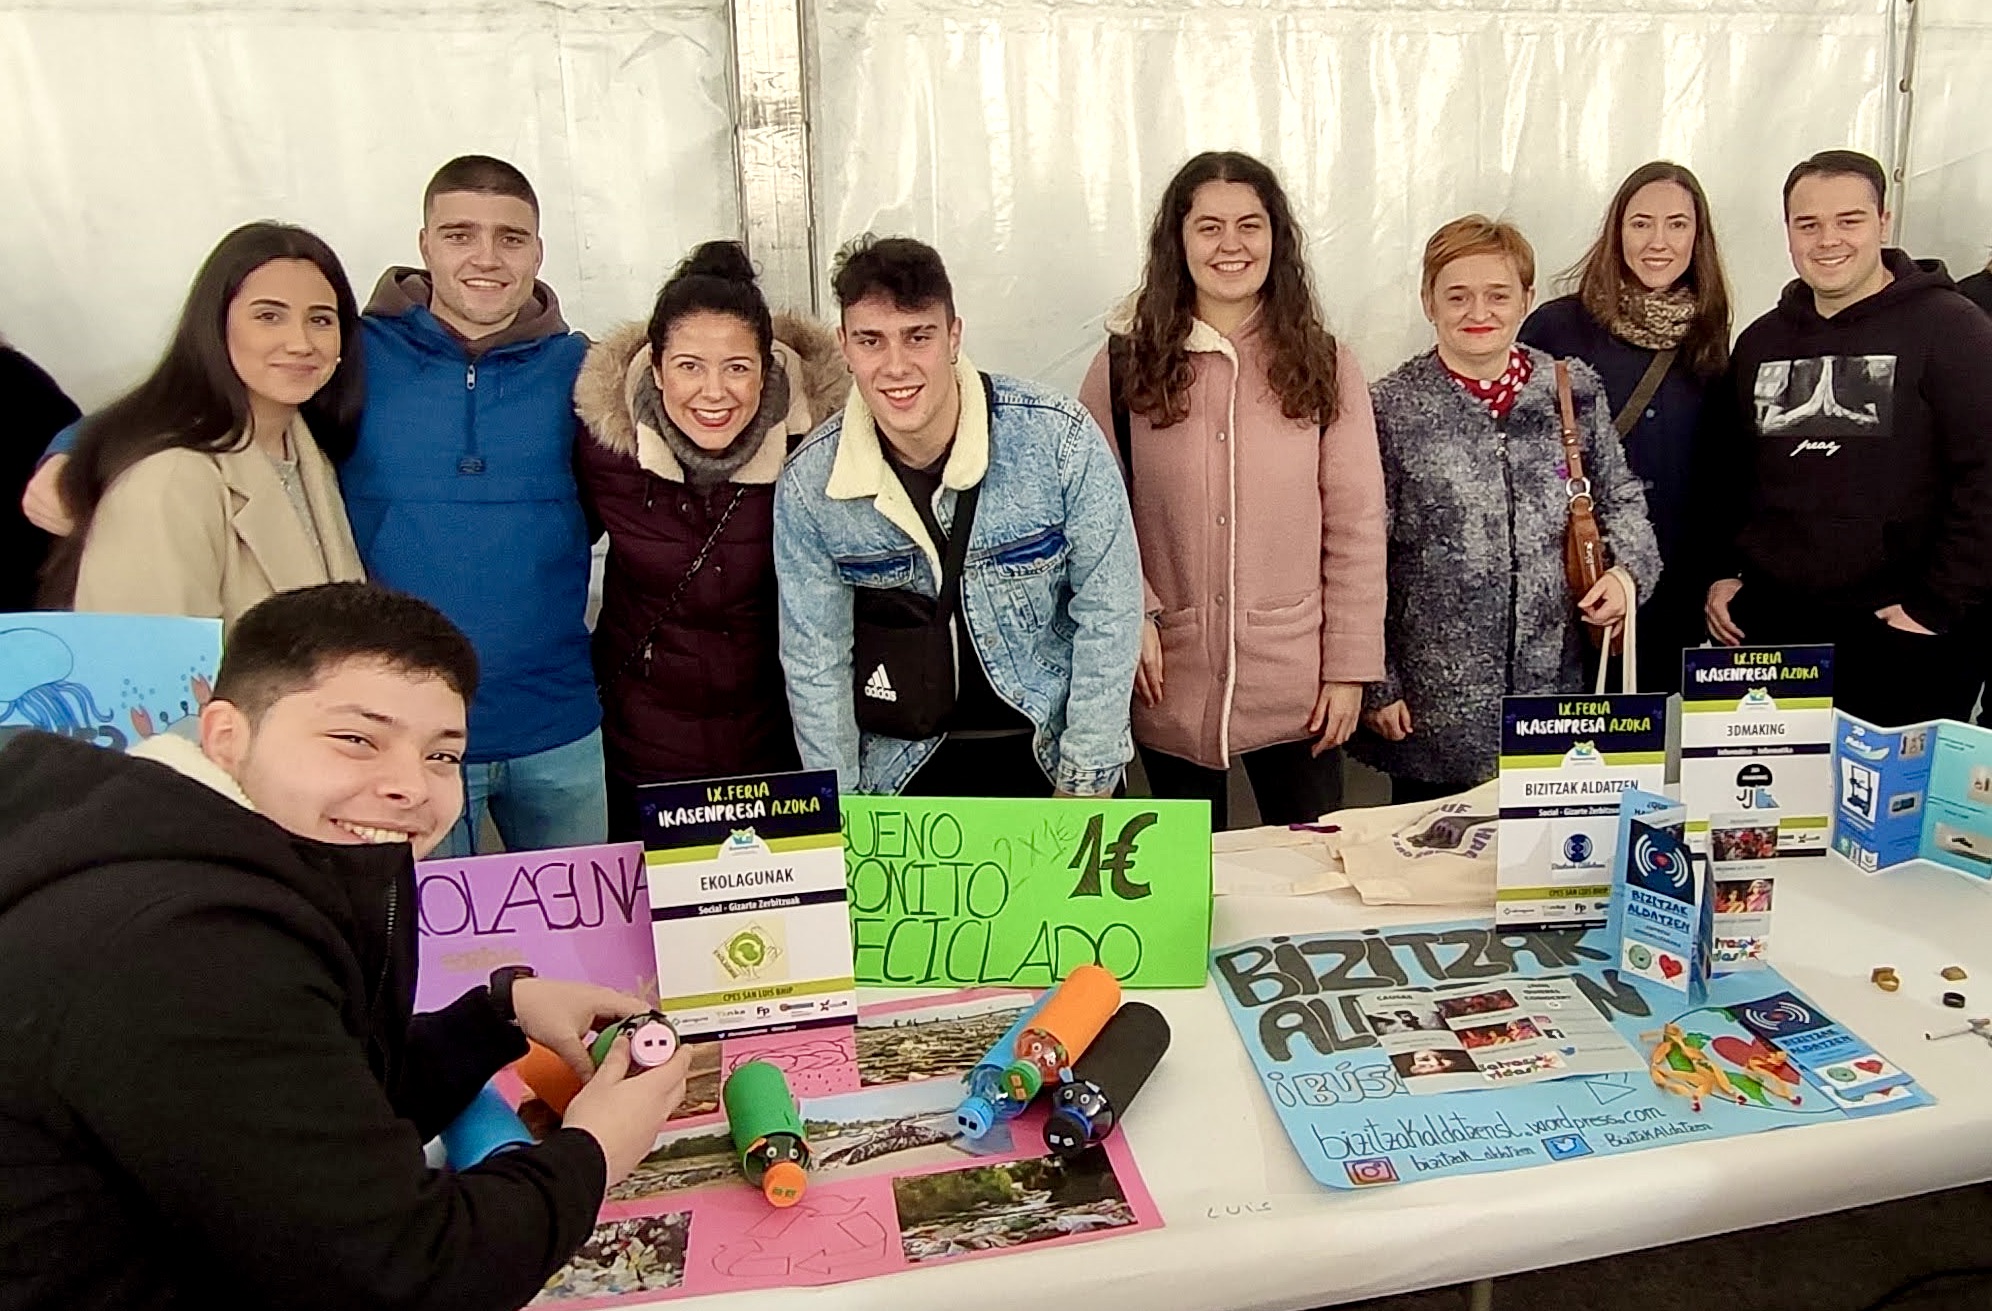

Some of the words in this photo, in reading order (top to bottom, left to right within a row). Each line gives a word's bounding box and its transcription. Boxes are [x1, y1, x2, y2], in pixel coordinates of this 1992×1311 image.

[1696, 666, 1777, 683] IKASENPRESA
[1780, 667, 1818, 679] AZOKA
[864, 685, 897, 702] adidas
[1559, 700, 1610, 716] IX.FERIA
[1516, 718, 1605, 736] IKASENPRESA
[1609, 717, 1650, 732] AZOKA
[1727, 723, 1785, 737] 3DMAKING
[707, 781, 769, 803] IX.FERIA
[1526, 781, 1578, 797] BIZITZAK
[658, 800, 766, 828] IKASENPRESA
[771, 796, 820, 817] AZOKA
[1068, 812, 1158, 900] 1€
[700, 868, 794, 891] EKOLAGUNAK
[698, 902, 723, 915] Social
[728, 899, 757, 914] Gizarte
[759, 895, 800, 910] Zerbitzuak
[1632, 890, 1688, 916] BIZITZAK
[1628, 903, 1690, 934] ALDATZEN
[742, 990, 758, 1000] SAN
[1207, 1201, 1271, 1219] LUIS
